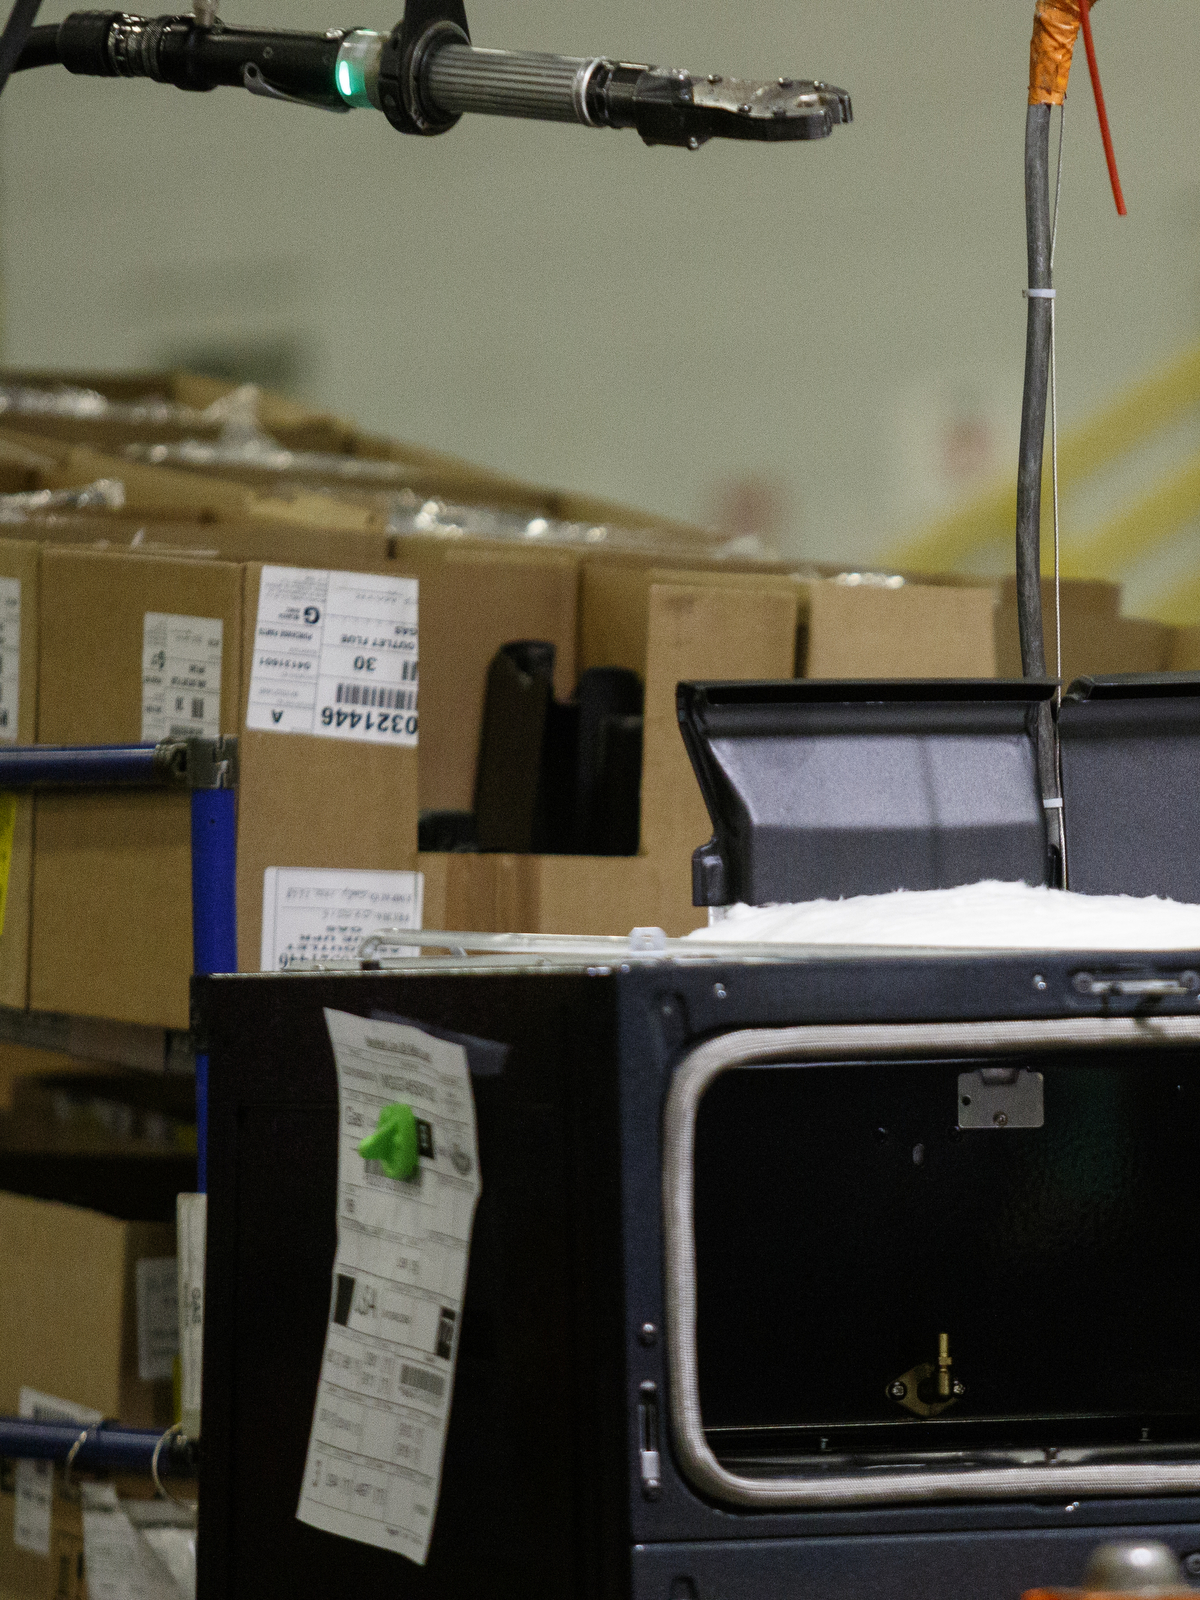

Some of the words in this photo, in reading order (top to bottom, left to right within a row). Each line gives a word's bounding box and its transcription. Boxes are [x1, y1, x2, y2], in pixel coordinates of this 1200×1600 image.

[372, 639, 415, 650] OUTLET
[354, 656, 377, 671] 30
[271, 710, 284, 724] A
[321, 707, 418, 735] 0321446
